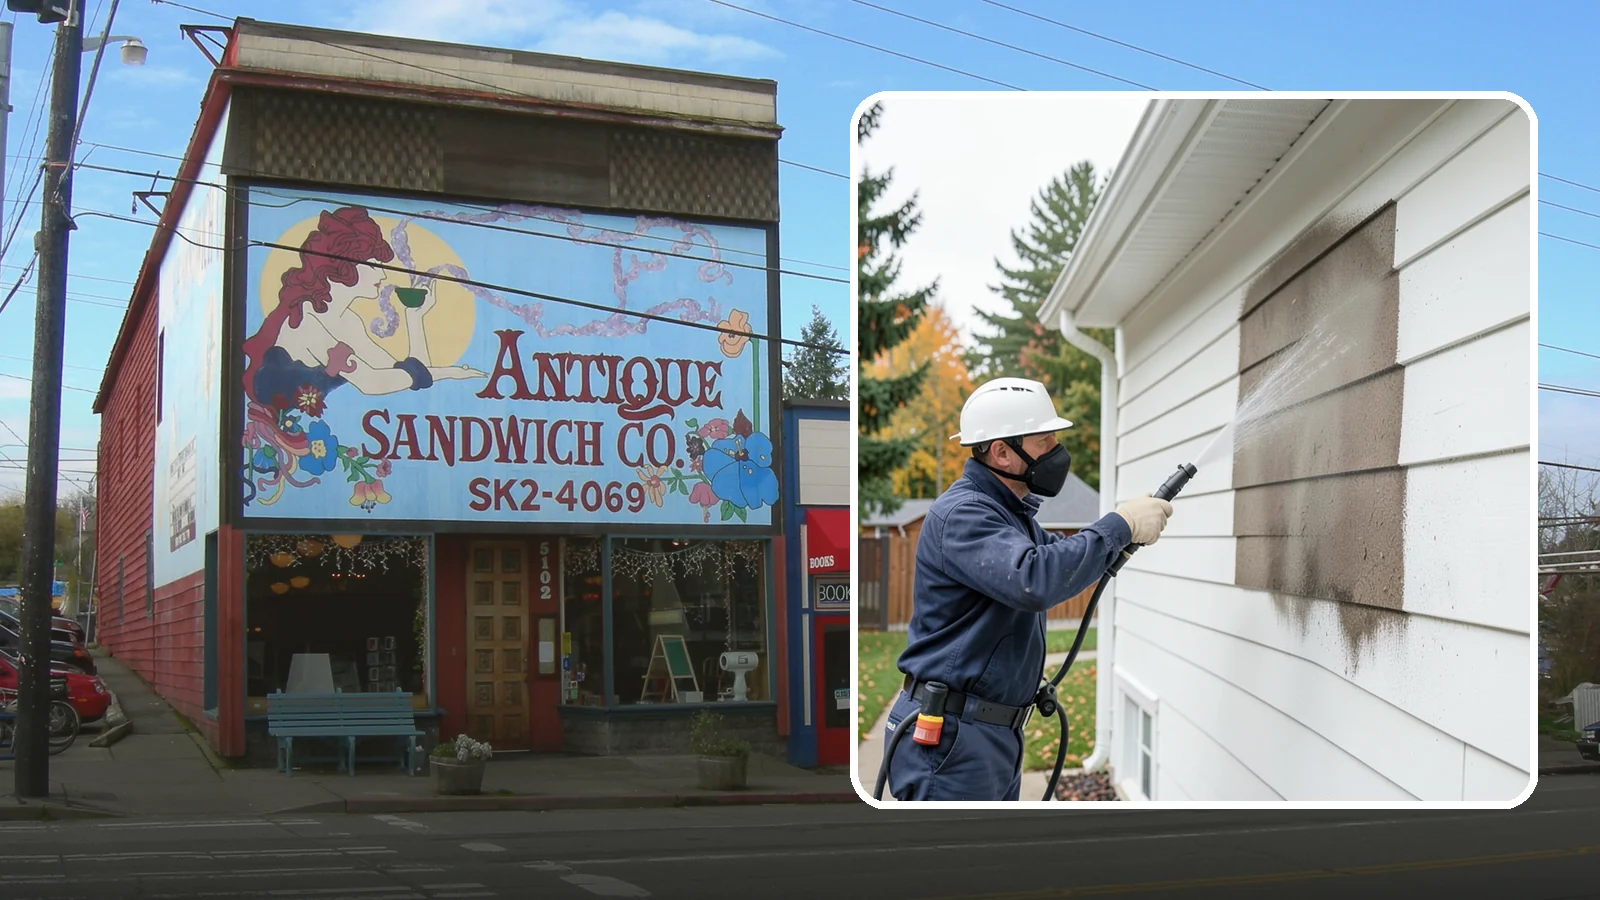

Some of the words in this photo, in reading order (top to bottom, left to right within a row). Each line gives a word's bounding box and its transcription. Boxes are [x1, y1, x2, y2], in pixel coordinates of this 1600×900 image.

[475, 328, 723, 421] ANTIQUE
[362, 409, 605, 467] SANDWICH
[617, 422, 686, 468] CO.
[468, 477, 645, 514] SK2-4069
[540, 542, 553, 600] 5102
[809, 555, 835, 569] BOOKS
